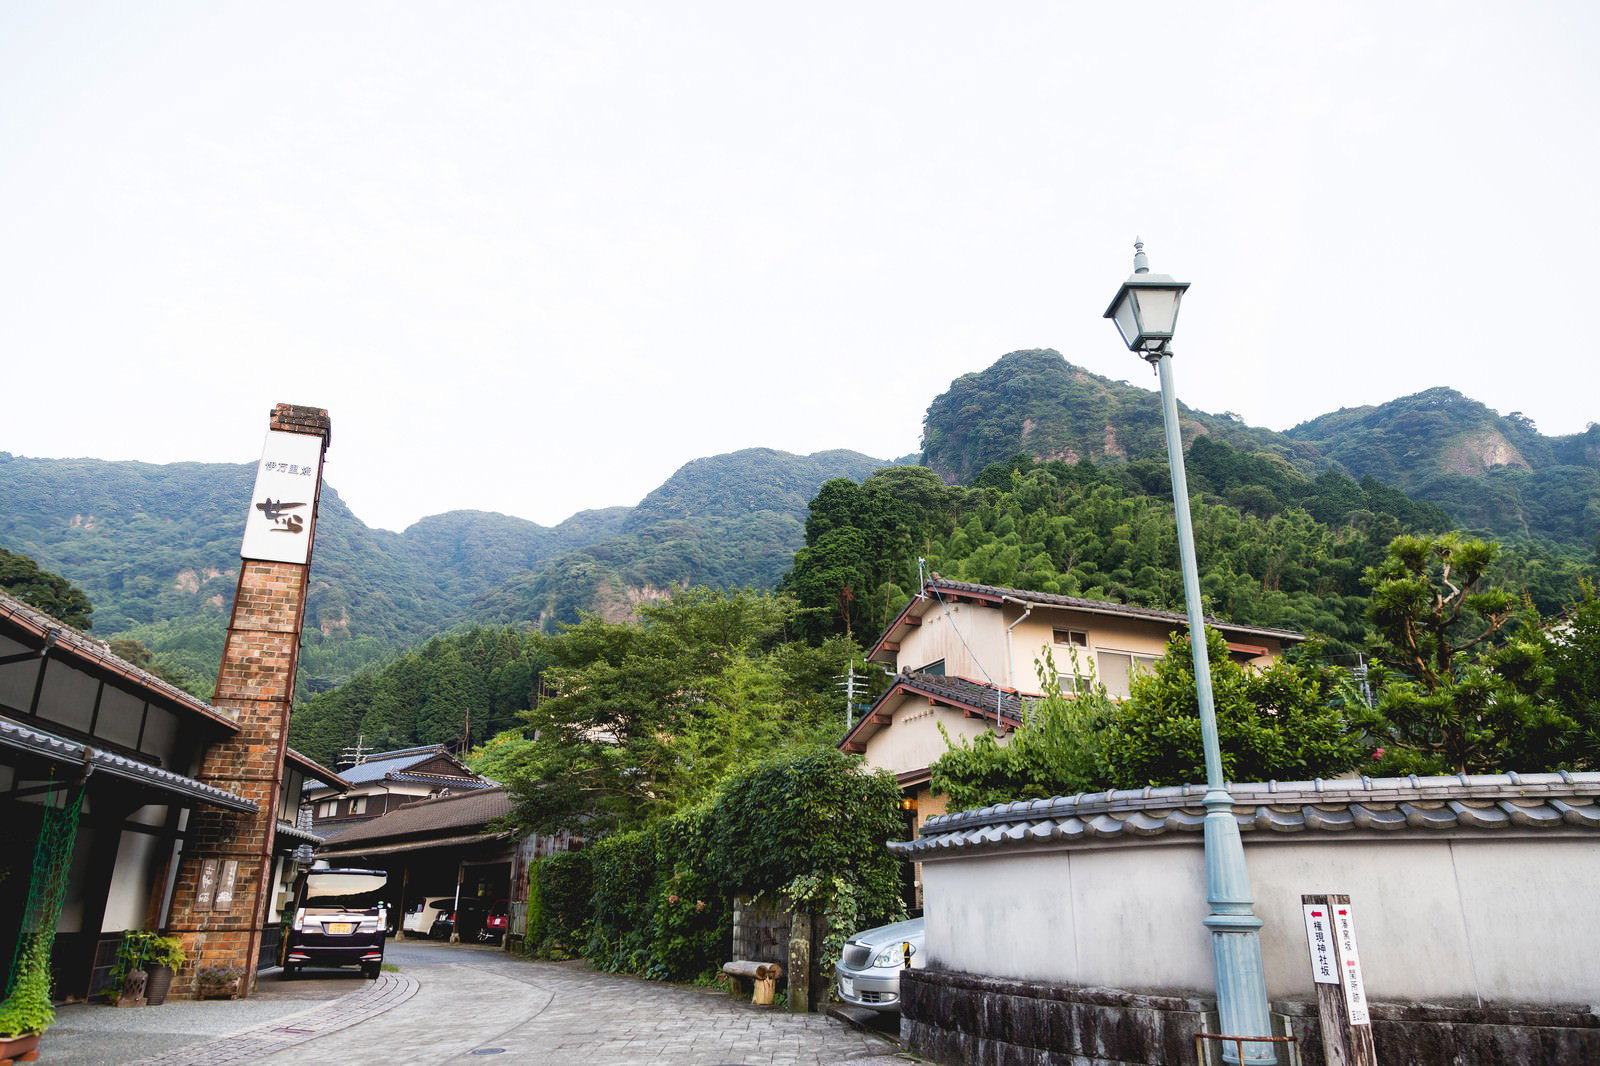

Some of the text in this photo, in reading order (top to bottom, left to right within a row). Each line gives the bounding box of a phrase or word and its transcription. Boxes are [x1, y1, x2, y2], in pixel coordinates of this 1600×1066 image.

[1313, 920, 1331, 976] 権現神社坂
